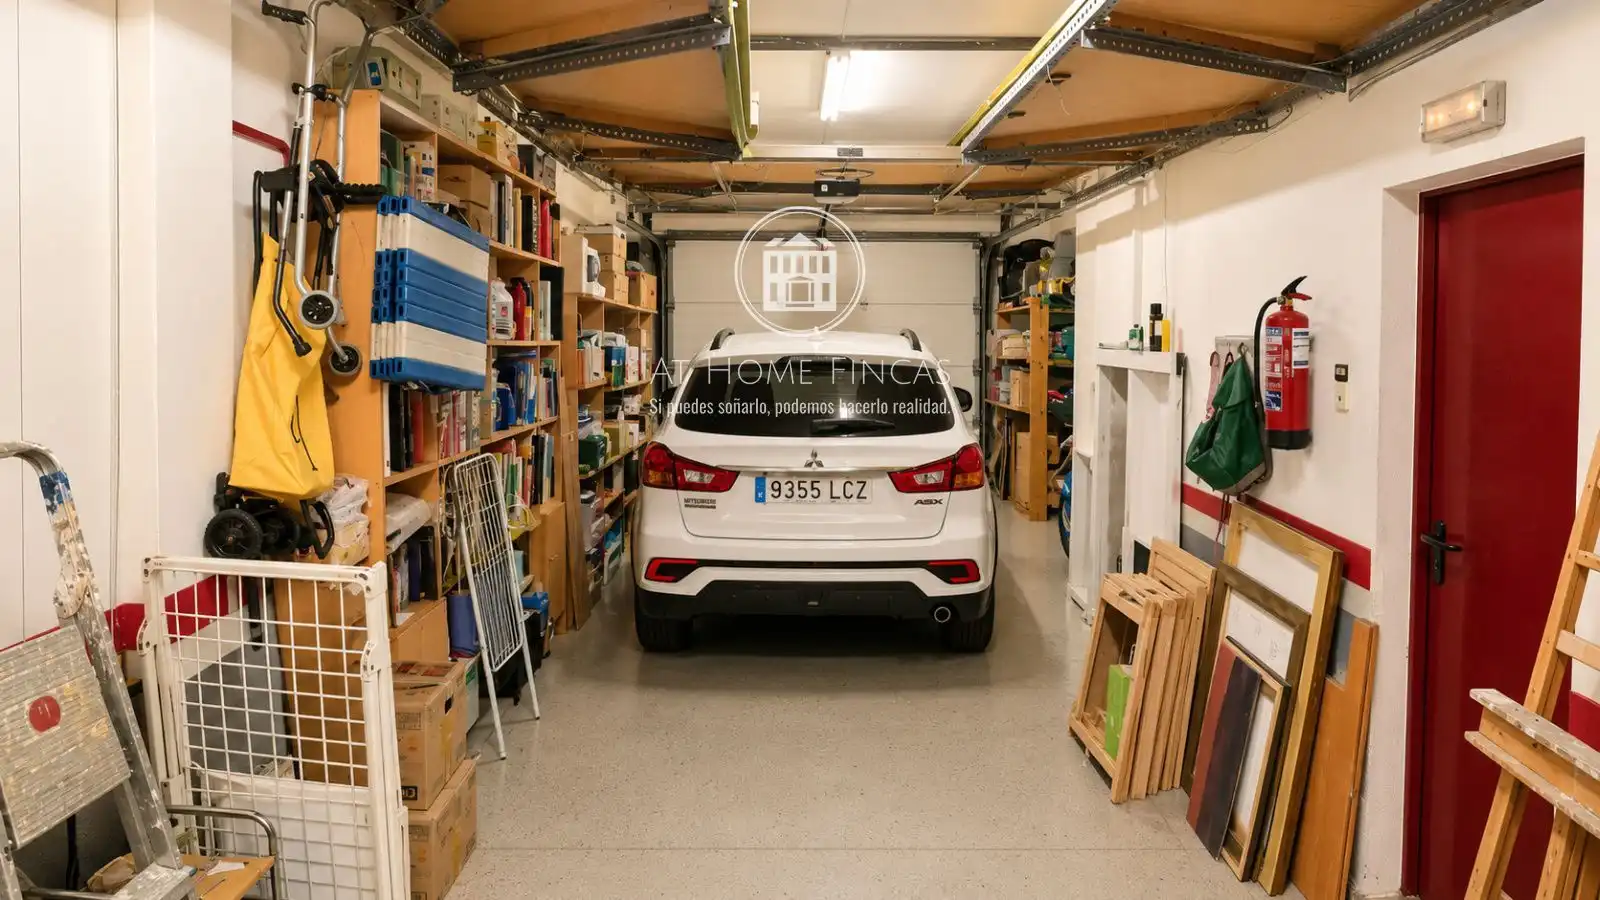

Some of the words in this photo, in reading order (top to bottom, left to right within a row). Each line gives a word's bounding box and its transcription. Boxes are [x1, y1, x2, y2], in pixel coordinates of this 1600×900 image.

[770, 480, 821, 499] 9355
[829, 480, 867, 500] LCZ
[914, 498, 943, 506] ASX
